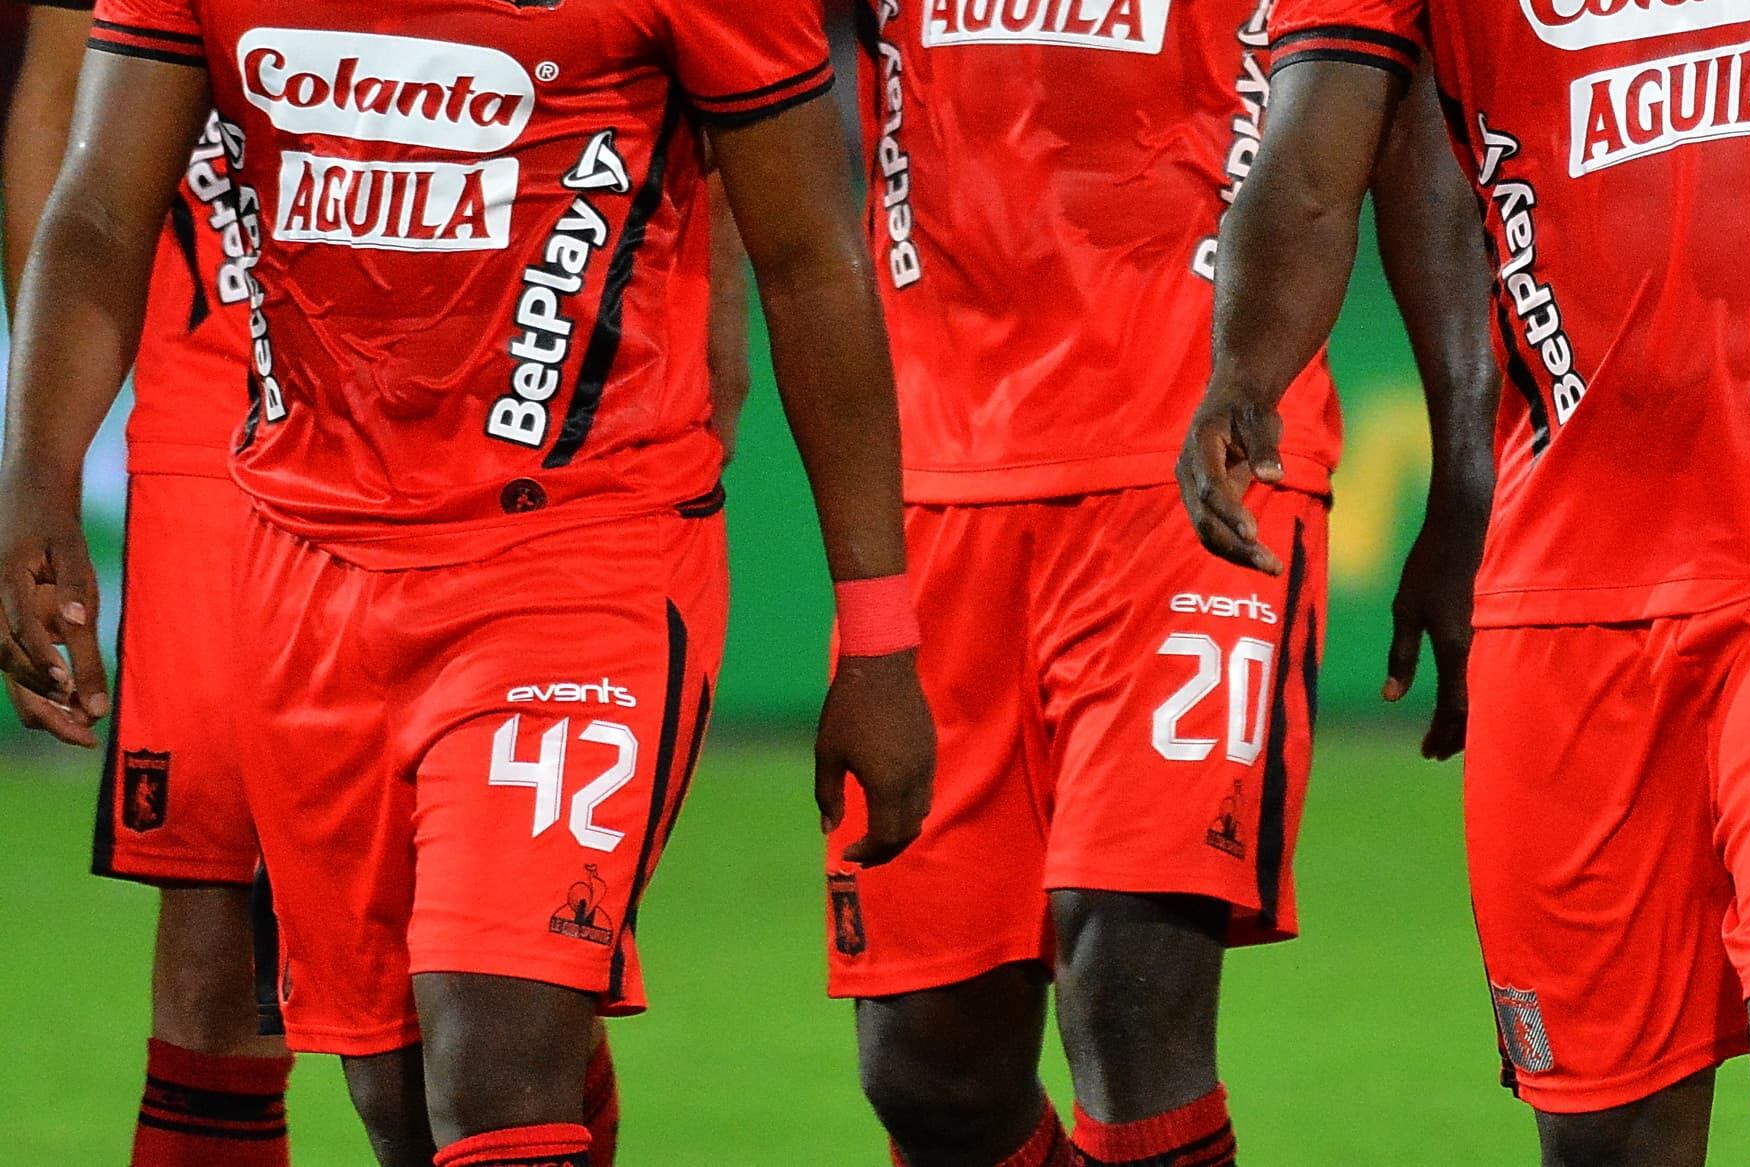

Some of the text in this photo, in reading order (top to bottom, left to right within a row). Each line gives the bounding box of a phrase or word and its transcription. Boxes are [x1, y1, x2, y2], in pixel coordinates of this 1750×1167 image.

[245, 47, 529, 128] Colanta
[283, 161, 492, 242] AGUILA
[487, 197, 607, 447] BetPlay
[1495, 180, 1588, 426] BetPlay
[1151, 631, 1275, 767] 20
[487, 712, 639, 853] 42
